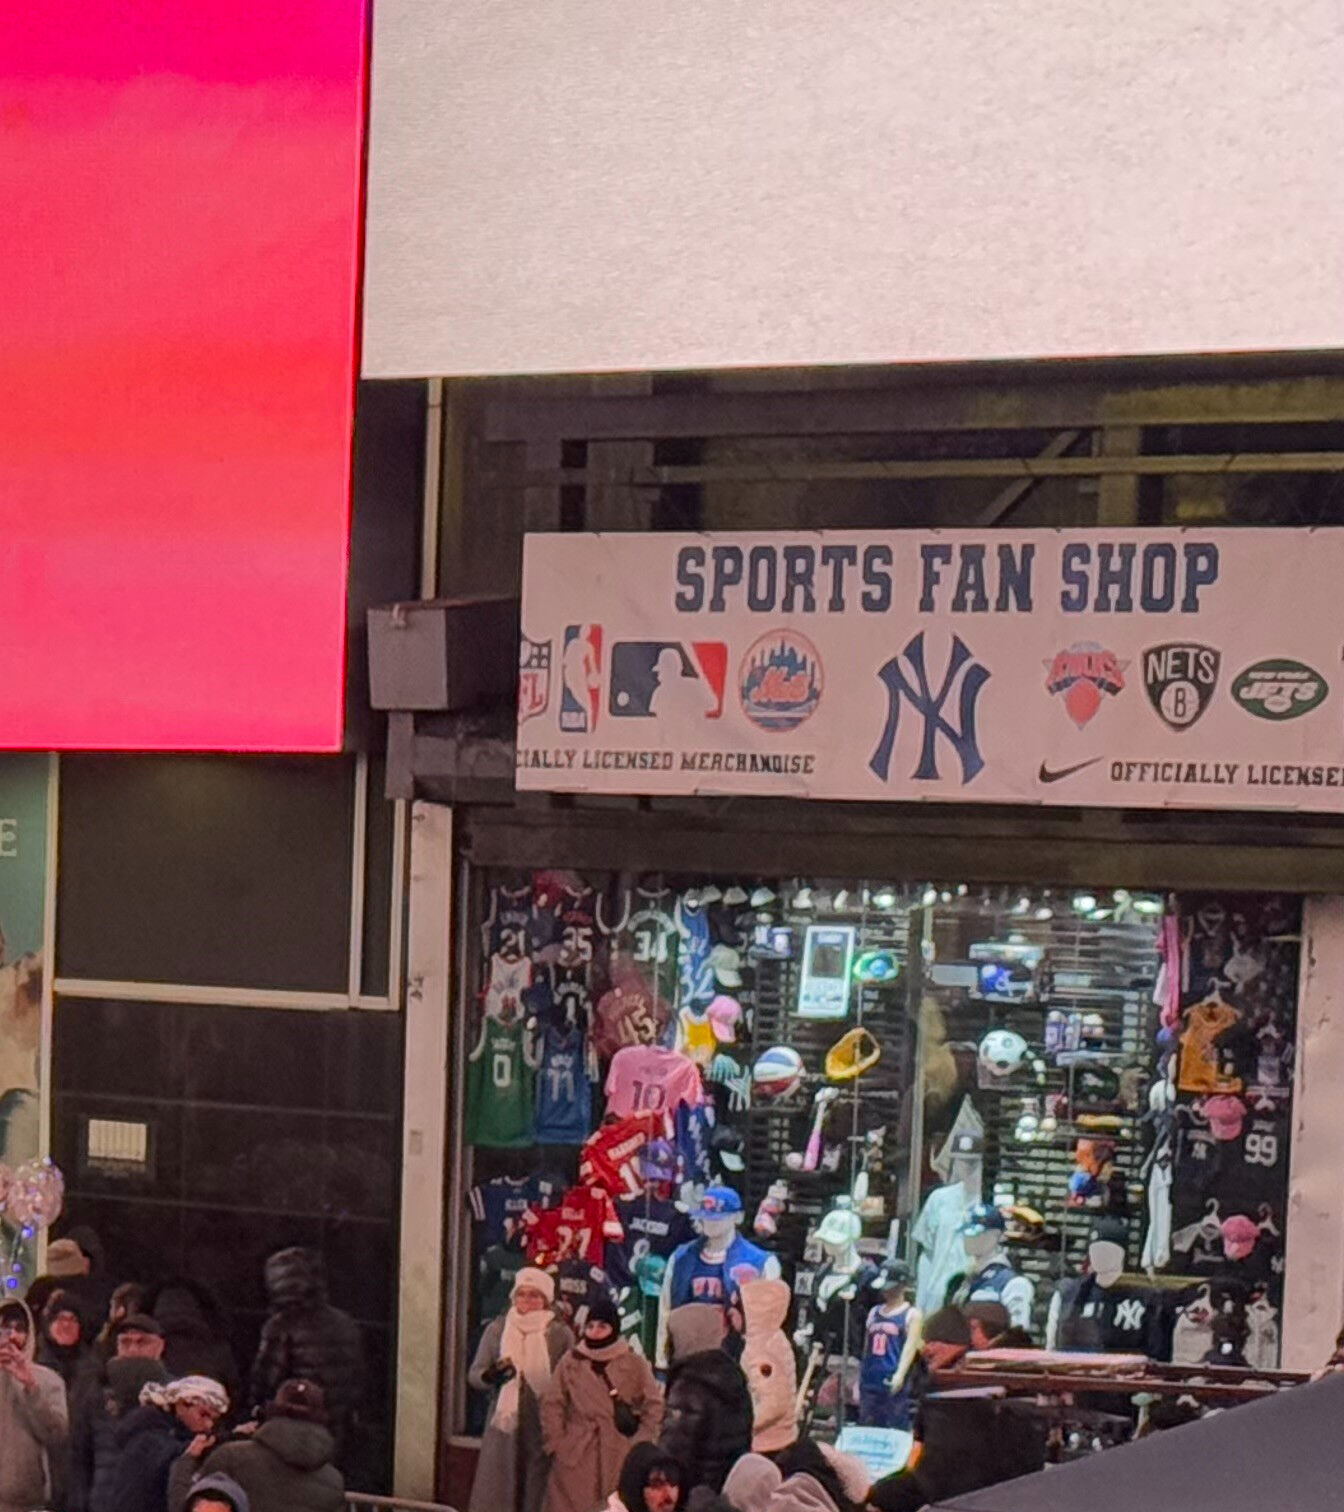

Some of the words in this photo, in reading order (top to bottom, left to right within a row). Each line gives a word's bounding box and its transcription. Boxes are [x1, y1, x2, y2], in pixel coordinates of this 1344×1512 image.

[675, 544, 894, 613] SPORTS
[919, 543, 1035, 613] FAN
[1061, 542, 1220, 613] SHOP
[1147, 648, 1215, 685] NETS
[868, 630, 992, 786] NY
[1173, 687, 1187, 720] B
[1239, 682, 1318, 701] JETS
[582, 750, 673, 770] LICENSED
[679, 752, 816, 775] MERCHANDISE
[1111, 760, 1240, 786] OFFICIALLY
[1246, 763, 1344, 788] LICENSE
[493, 1053, 512, 1088] 0
[632, 1080, 666, 1110] 10
[1244, 1133, 1278, 1167] 99
[629, 1216, 669, 1236] JACKSON
[1114, 1298, 1146, 1331] NY
